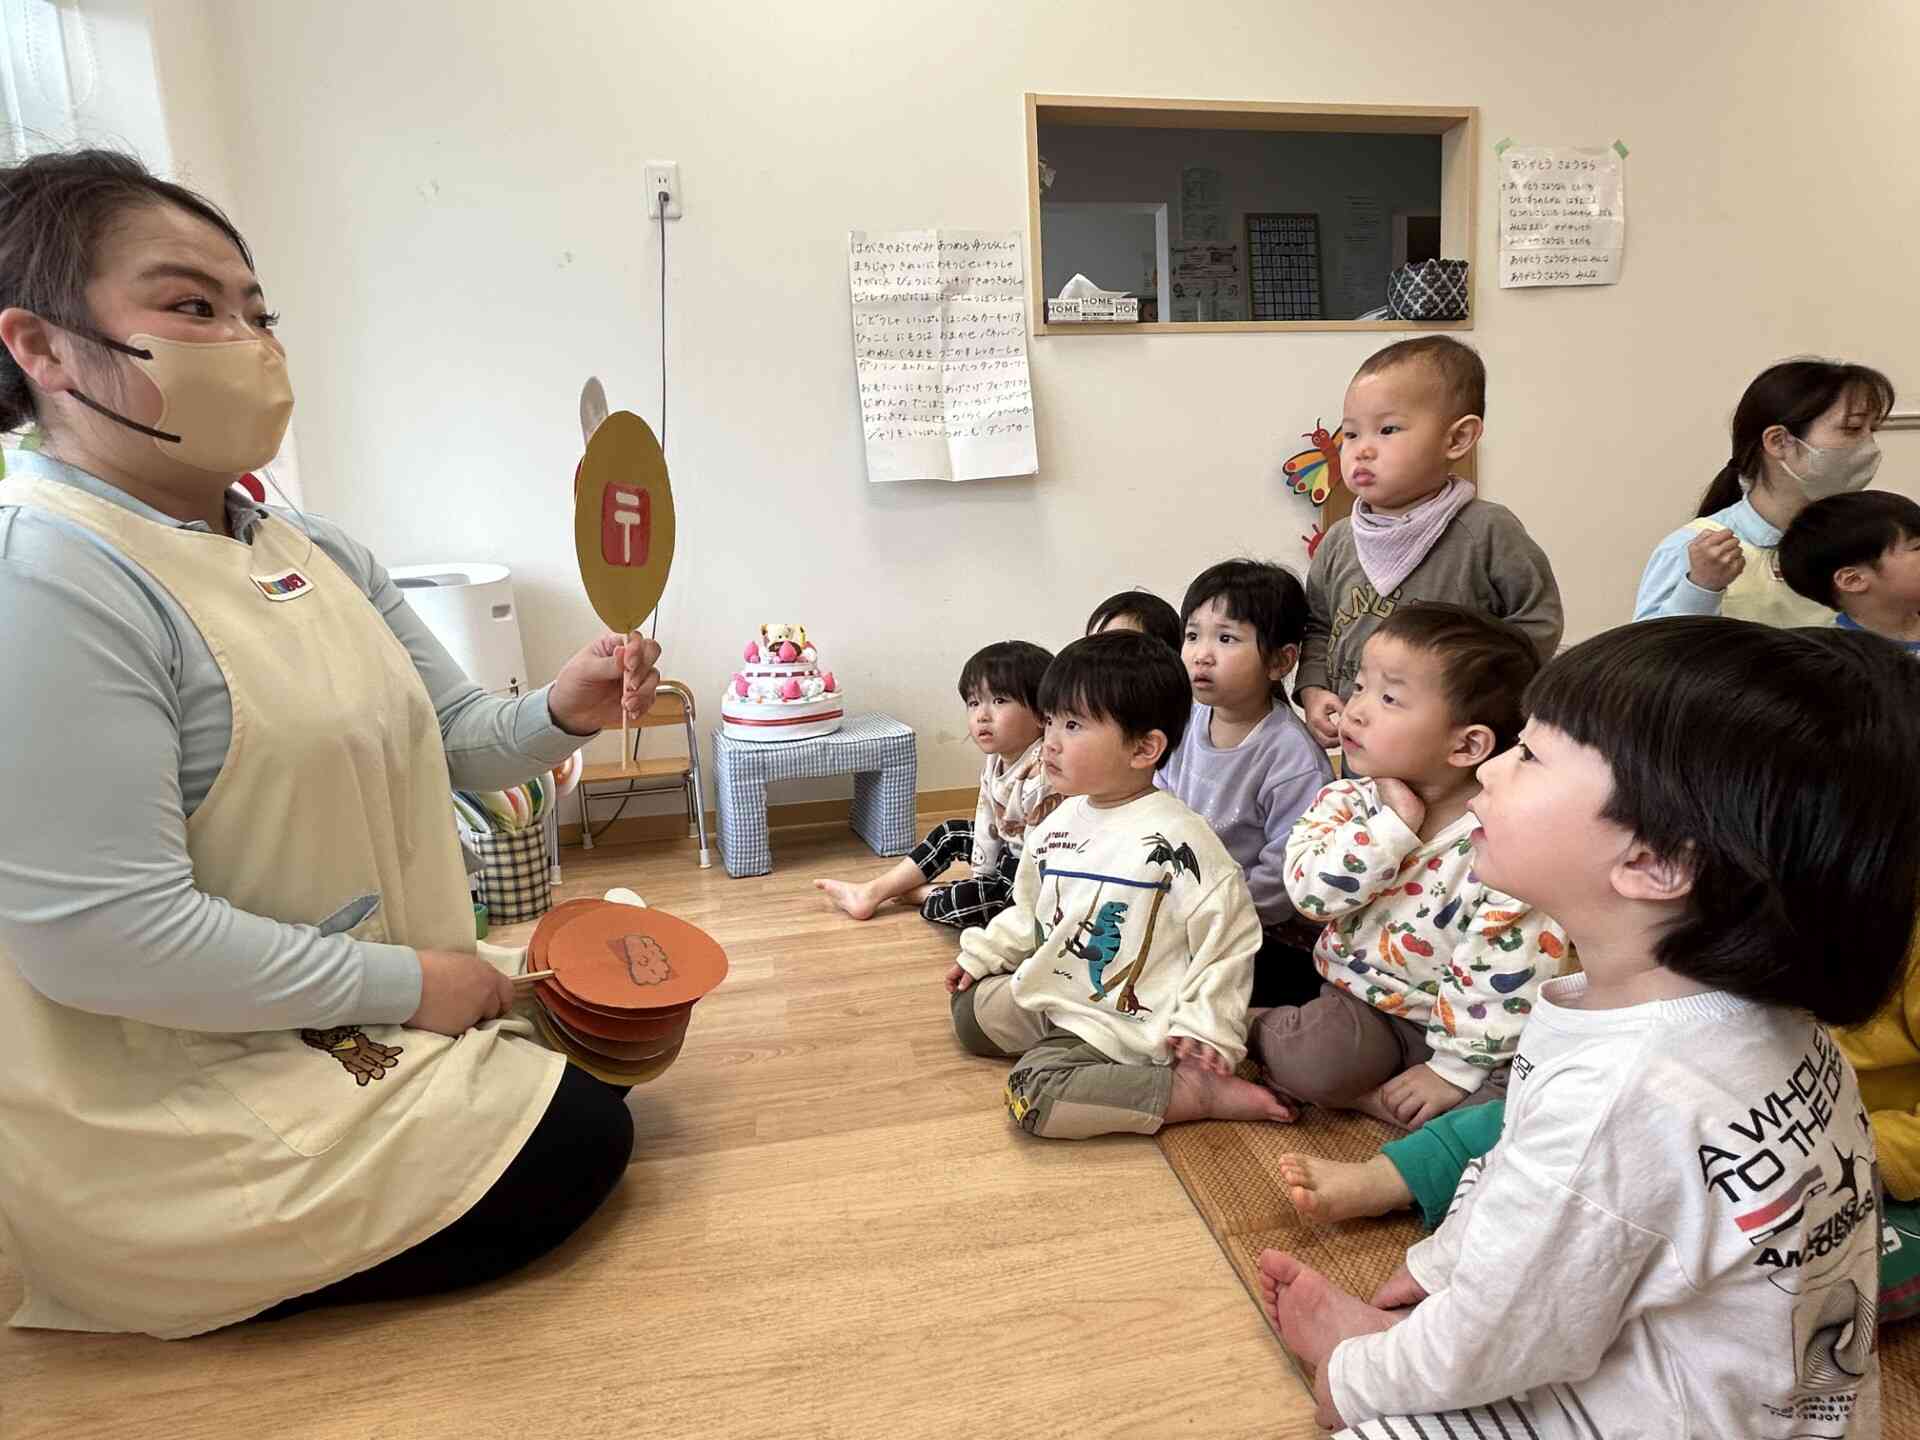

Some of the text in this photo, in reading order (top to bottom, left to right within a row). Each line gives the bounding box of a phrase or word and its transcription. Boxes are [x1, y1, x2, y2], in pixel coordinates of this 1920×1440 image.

[1081, 297, 1113, 305] HOME
[1698, 1144, 1742, 1188] A
[1708, 1089, 1833, 1203] TO THE
